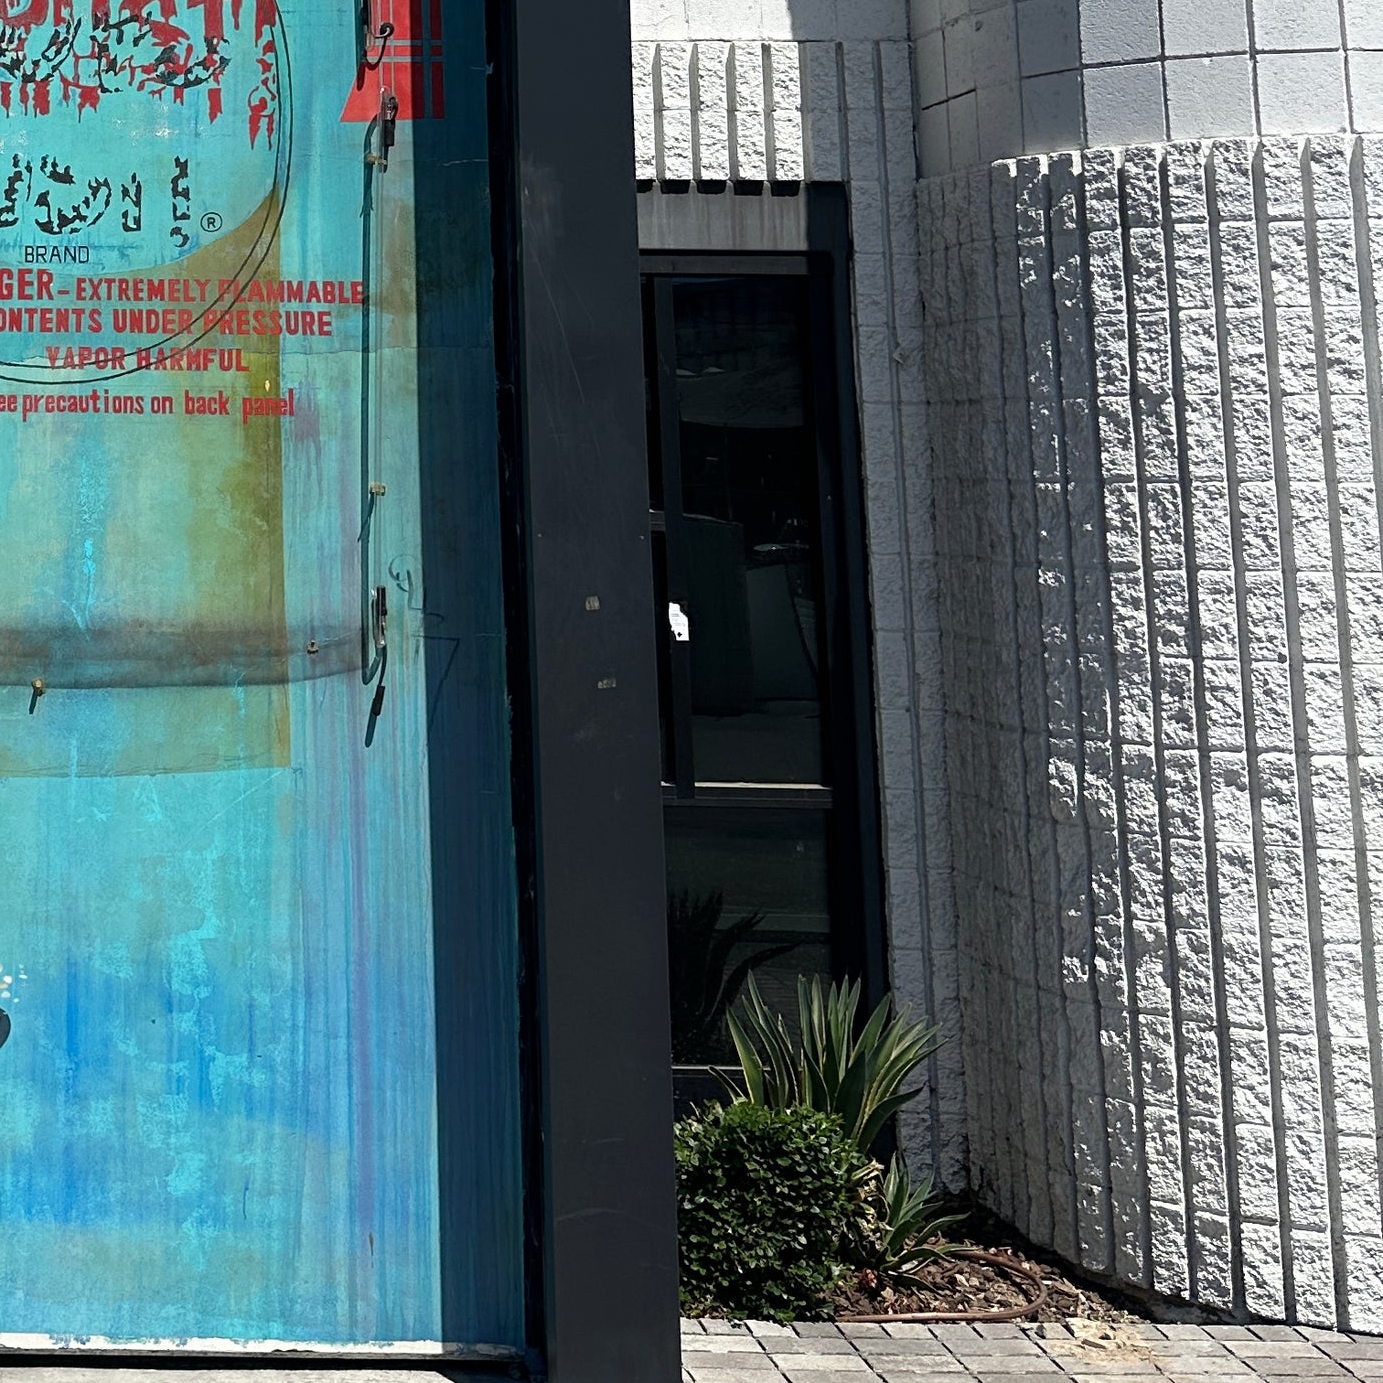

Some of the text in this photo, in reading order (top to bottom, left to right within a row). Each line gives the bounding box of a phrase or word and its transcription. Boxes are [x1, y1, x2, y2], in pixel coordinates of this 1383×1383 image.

[23, 245, 90, 264] BRAND
[75, 277, 211, 303] EXTREMELY
[217, 279, 365, 305] FLAMMABLE
[112, 308, 194, 335] UNDER
[203, 309, 333, 336] PRESSURE
[46, 346, 250, 373] VAPOR HARMFUL
[22, 388, 145, 423] precautions
[150, 395, 175, 415] on
[184, 389, 230, 416] back
[242, 388, 295, 425] panel
